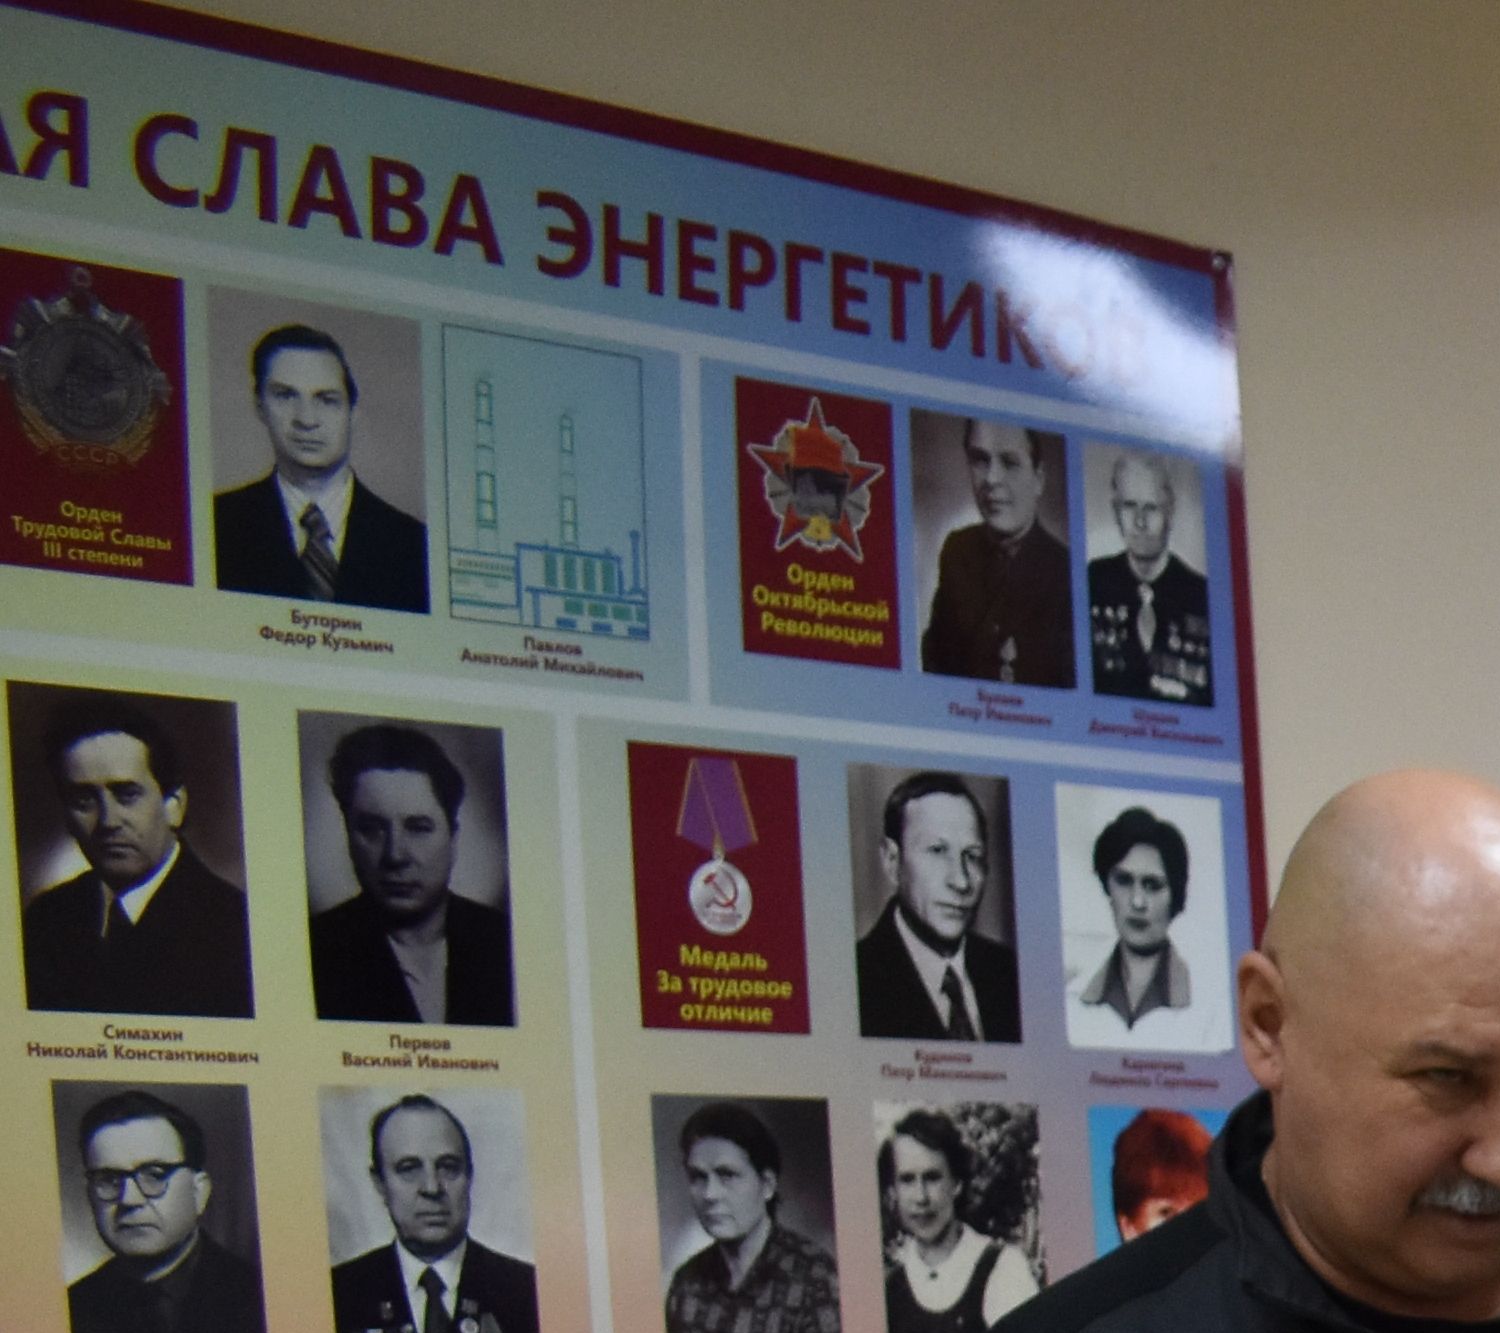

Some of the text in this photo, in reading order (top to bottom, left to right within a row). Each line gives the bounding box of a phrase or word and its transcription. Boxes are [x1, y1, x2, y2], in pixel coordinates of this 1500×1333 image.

[133, 114, 504, 267] СЛАВА
[536, 188, 1145, 388] ЭНЕРГЕТИКО
[60, 500, 122, 524] Орден
[12, 515, 172, 551] Трудовой Славы
[43, 542, 143, 567] III степени
[787, 564, 854, 591] Орден
[753, 586, 890, 621] Октябрьской
[292, 609, 363, 632] Буторин
[761, 612, 884, 646] Революции
[260, 626, 394, 654] Федор Кузьмич
[524, 636, 582, 656] Павлов
[461, 648, 643, 681] Анатолий Михайлович
[679, 945, 767, 972] Медаль
[656, 971, 793, 1003] За трудовое
[680, 1004, 773, 1024] отличие
[102, 1024, 183, 1043] Симахин
[389, 1034, 451, 1053] Первов
[27, 1041, 259, 1064] Николай Константинович
[342, 1050, 499, 1071] Василий Иванович
